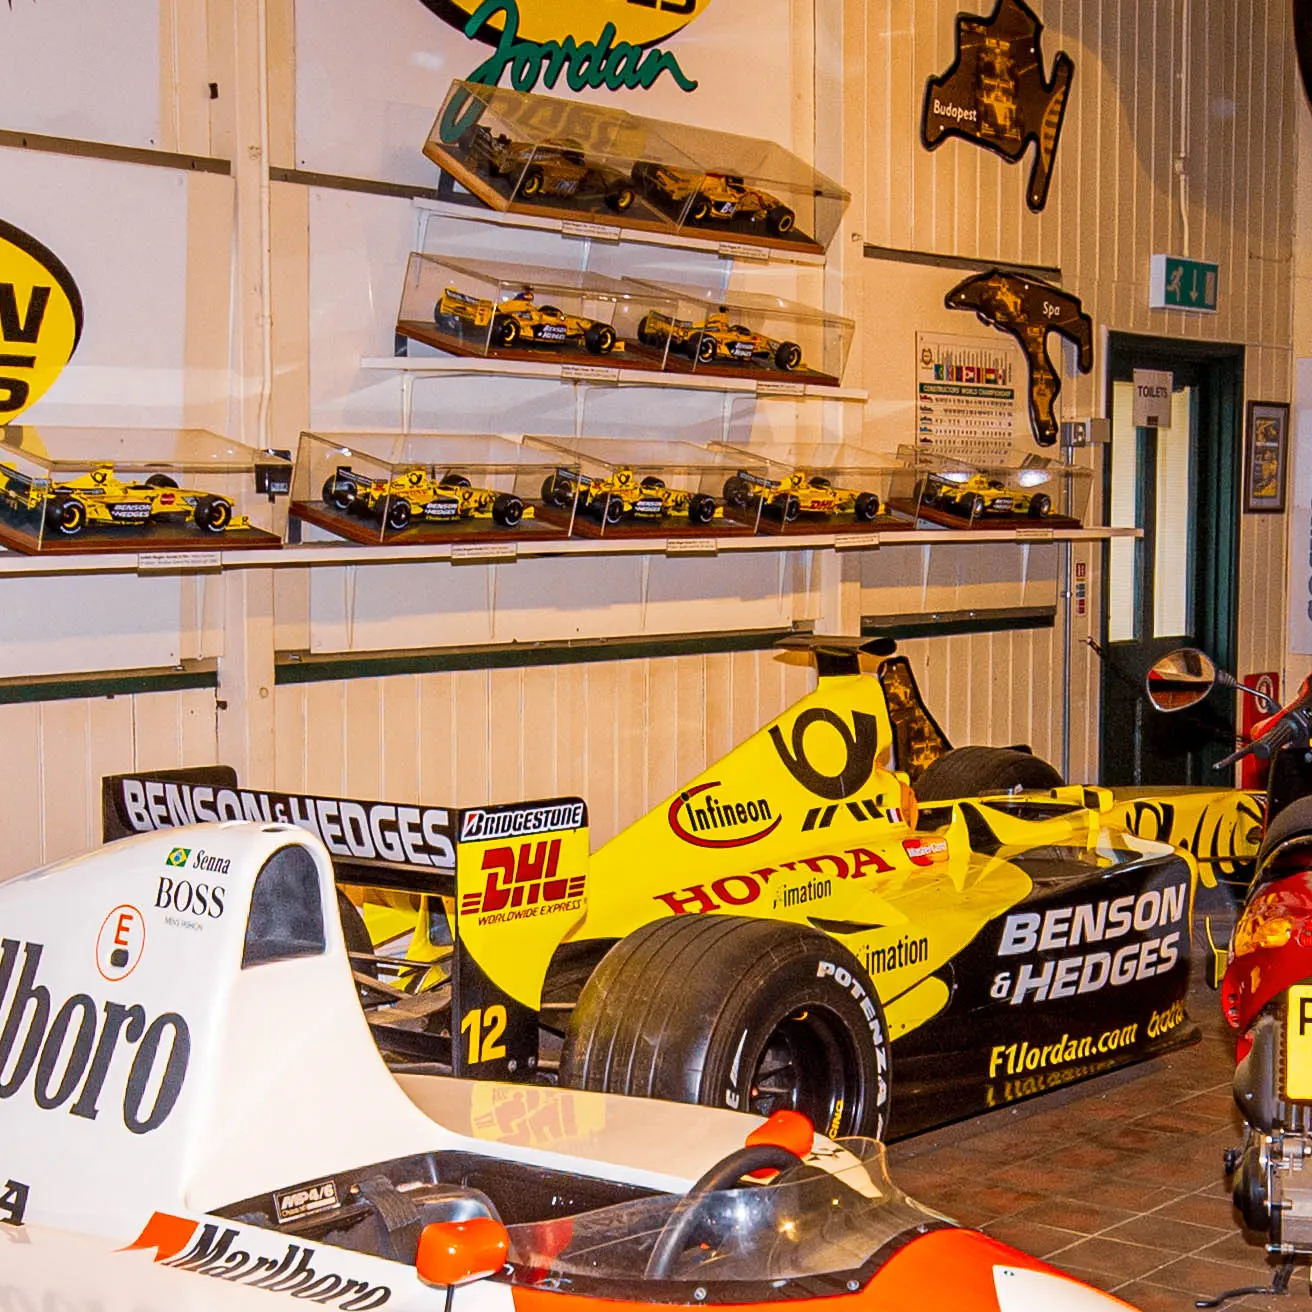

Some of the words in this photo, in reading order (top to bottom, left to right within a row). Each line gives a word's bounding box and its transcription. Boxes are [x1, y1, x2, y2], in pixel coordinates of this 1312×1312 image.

[439, 2, 698, 143] Jordan
[933, 100, 977, 122] Budapest
[1042, 301, 1061, 317] Spa
[1138, 384, 1168, 398] TOILETS
[123, 779, 268, 832] BENSON
[290, 798, 454, 867] HEDGES
[464, 804, 582, 839] BRIDGESTONE
[193, 849, 231, 875] Senna
[483, 839, 568, 912] DHL
[154, 876, 225, 919] BOSS
[477, 907, 540, 927] WORLDWIDE
[539, 901, 583, 919] EXPRESS
[784, 878, 832, 907] imation
[113, 914, 134, 947] E
[997, 883, 1187, 957] BENSON
[865, 936, 928, 977] imation
[990, 971, 1012, 999] &
[1010, 931, 1181, 1006] HEDGES
[461, 1005, 508, 1064] 12
[816, 960, 888, 1108] POTENZA
[989, 1023, 1138, 1079] F1Jordan.com
[170, 1222, 392, 1312] Marlboro
